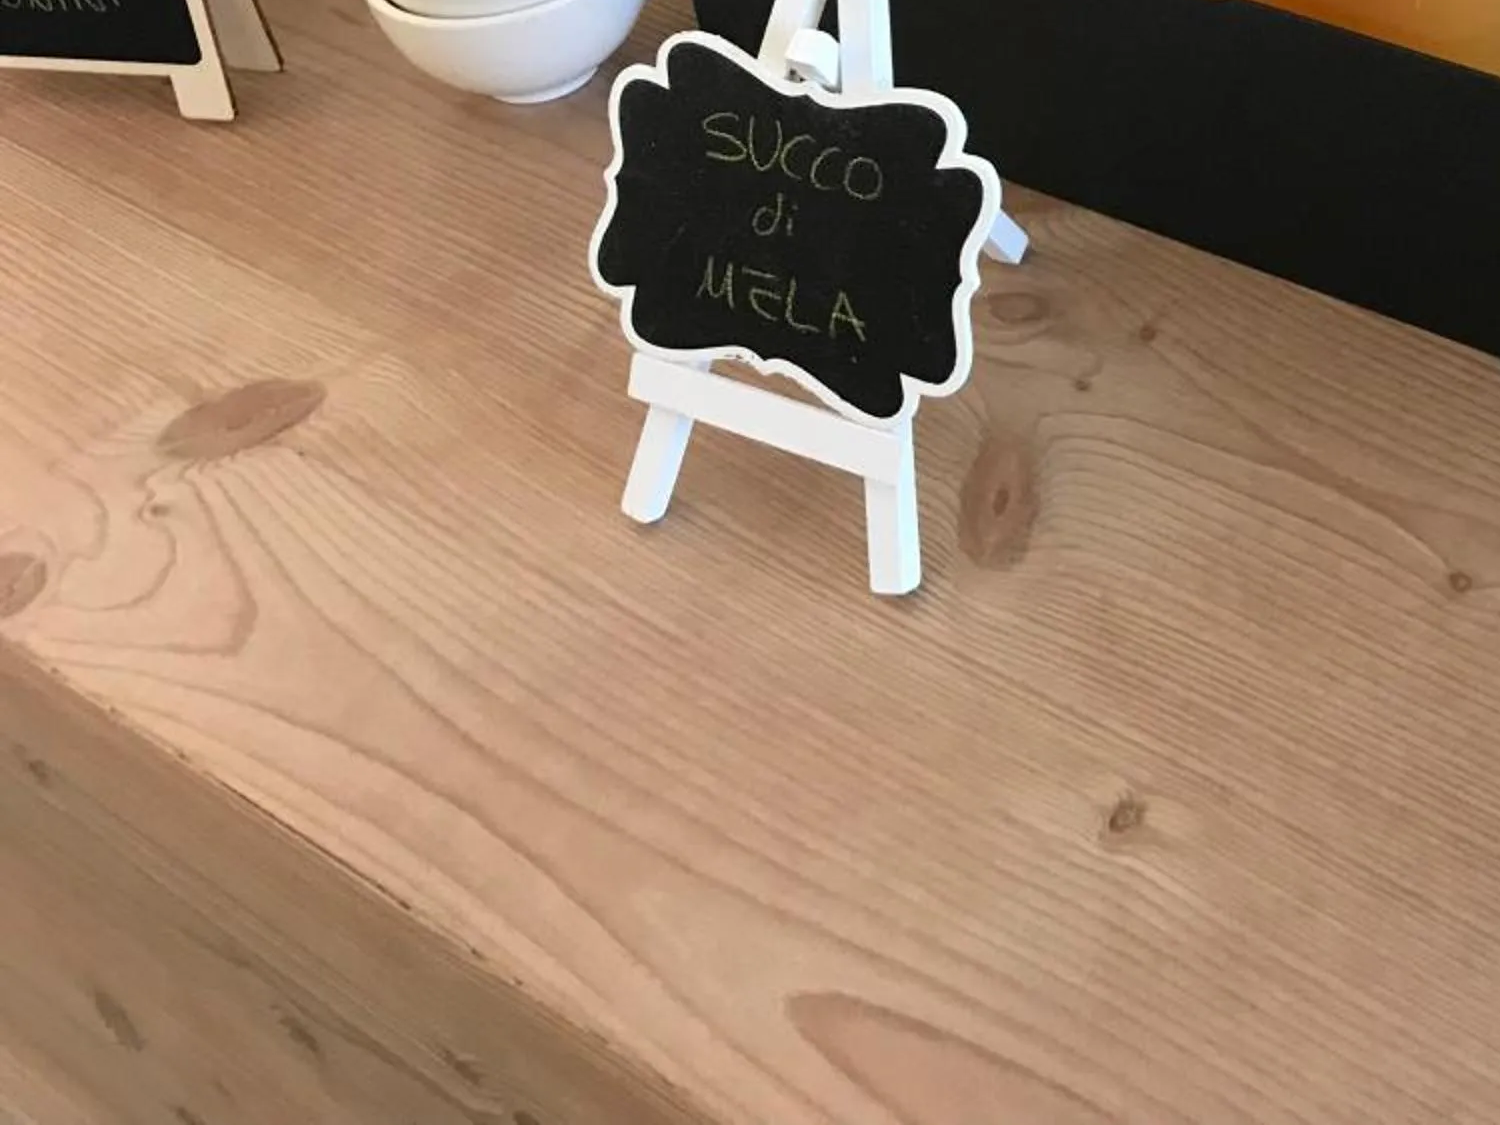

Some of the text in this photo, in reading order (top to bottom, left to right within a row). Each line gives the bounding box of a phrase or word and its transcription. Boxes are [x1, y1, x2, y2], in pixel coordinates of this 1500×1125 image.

[702, 111, 884, 201] SUCCO
[751, 192, 799, 237] di
[696, 255, 867, 343] MELA
